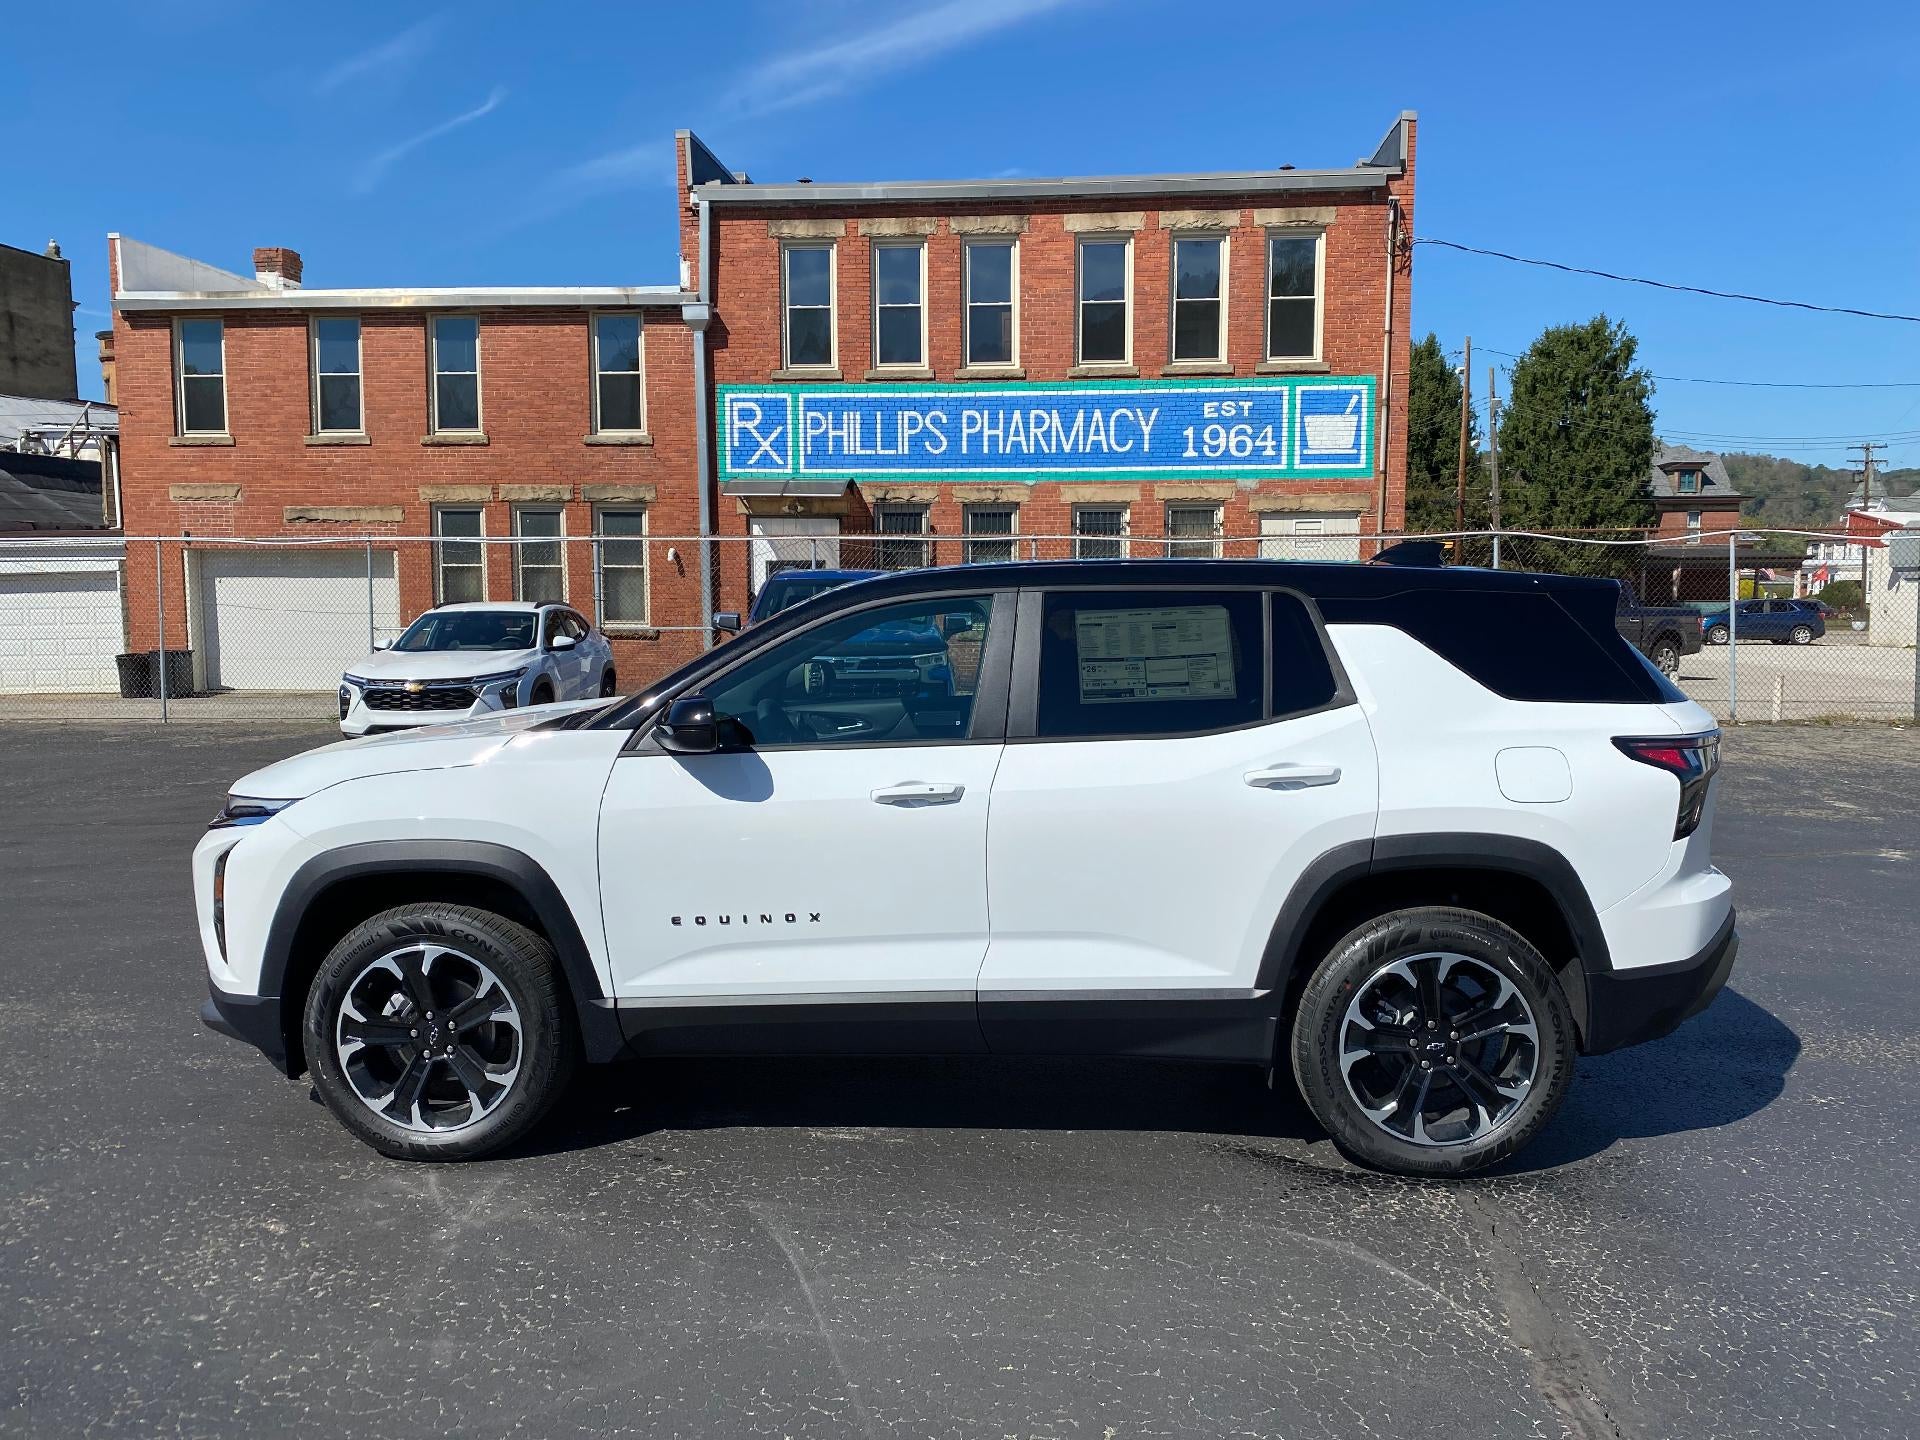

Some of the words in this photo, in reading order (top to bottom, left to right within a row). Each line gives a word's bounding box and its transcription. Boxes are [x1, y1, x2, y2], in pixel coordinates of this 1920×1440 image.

[1203, 401, 1253, 418] EST
[806, 411, 948, 455] PHILLIPS
[961, 407, 1159, 454] PHARMACY
[1182, 424, 1277, 458] 1964
[670, 911, 822, 927] EQUINOX
[331, 936, 376, 979] Continental
